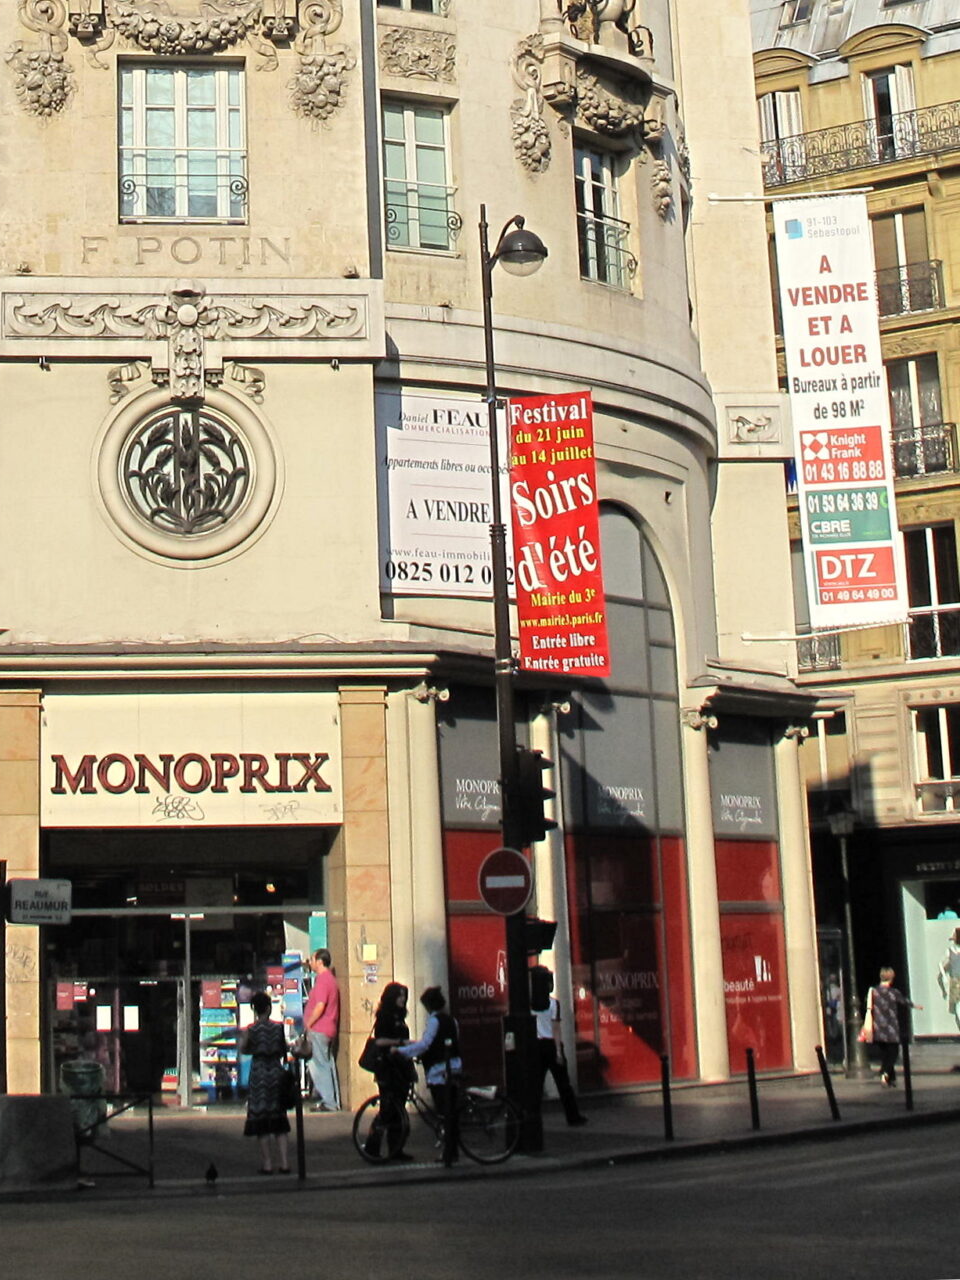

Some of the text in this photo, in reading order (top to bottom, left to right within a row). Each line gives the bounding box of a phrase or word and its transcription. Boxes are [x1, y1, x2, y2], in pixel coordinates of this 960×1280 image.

[806, 215, 838, 228] 91-103
[81, 236, 291, 266] F. POTIN
[819, 254, 833, 274] A
[787, 281, 870, 308] VENDRE
[808, 314, 854, 336] ET A
[800, 343, 868, 368] LOUER
[793, 370, 881, 395] Bureaux à partir
[433, 408, 489, 429] FEAU
[510, 398, 588, 426] Festival
[814, 402, 829, 420] de
[831, 400, 847, 418] 98
[401, 422, 490, 438] OMMERCIALISATION
[516, 425, 585, 444] du 21 juin
[830, 433, 867, 447] Knight
[511, 446, 593, 466] au 14 juillet
[832, 447, 863, 460] Frank
[441, 459, 463, 473] libres
[465, 463, 476, 473] ou
[477, 463, 511, 476] occpés
[805, 460, 883, 481] 01 43 16 88 88
[512, 470, 594, 527] Soirs
[808, 491, 878, 514] 01 53 64 36 39
[406, 498, 491, 524] A VENDRE
[811, 520, 852, 534] CBRE
[518, 525, 598, 593] d'été
[820, 553, 877, 580] DTZ
[385, 560, 515, 586] 0825 012 02
[531, 591, 567, 607] Mairie
[569, 590, 582, 604] du
[822, 591, 835, 601] 01
[852, 589, 865, 600] 64
[881, 588, 895, 598] 00
[520, 611, 604, 628] www.mairie3.paris.fr
[532, 632, 595, 650] Entrée libre
[524, 653, 605, 673] Entrée gratuite
[51, 753, 333, 795] MONOPRIX
[456, 778, 500, 795] MONOPR
[721, 794, 761, 809] MONOPRIX
[458, 981, 495, 1000] mode
[724, 977, 755, 992] beauté
